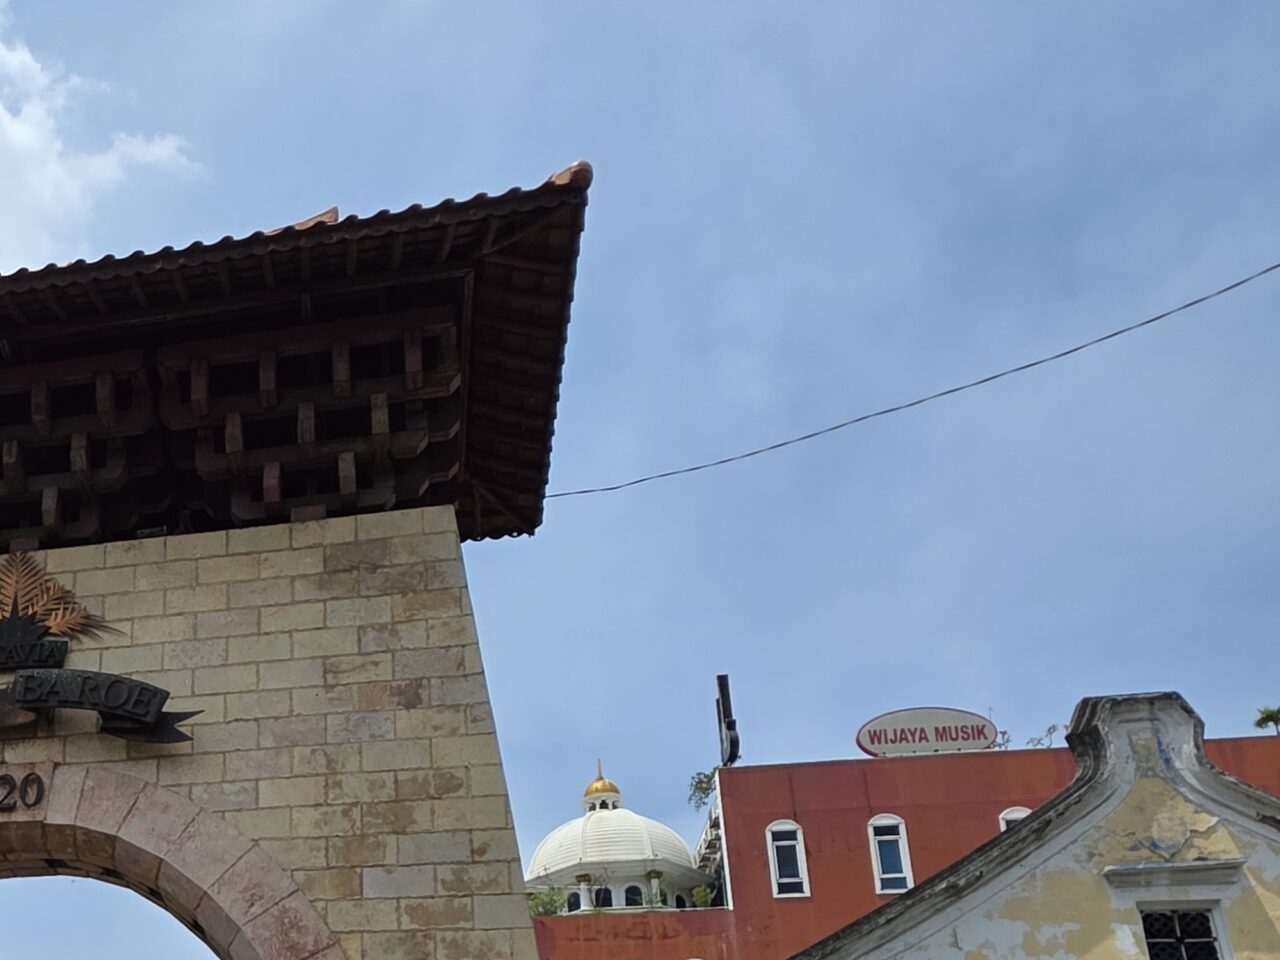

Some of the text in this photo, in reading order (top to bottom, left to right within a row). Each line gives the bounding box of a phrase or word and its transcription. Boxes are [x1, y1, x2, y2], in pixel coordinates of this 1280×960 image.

[19, 670, 156, 717] BAROE
[868, 724, 988, 745] WIJAYA MUSIK
